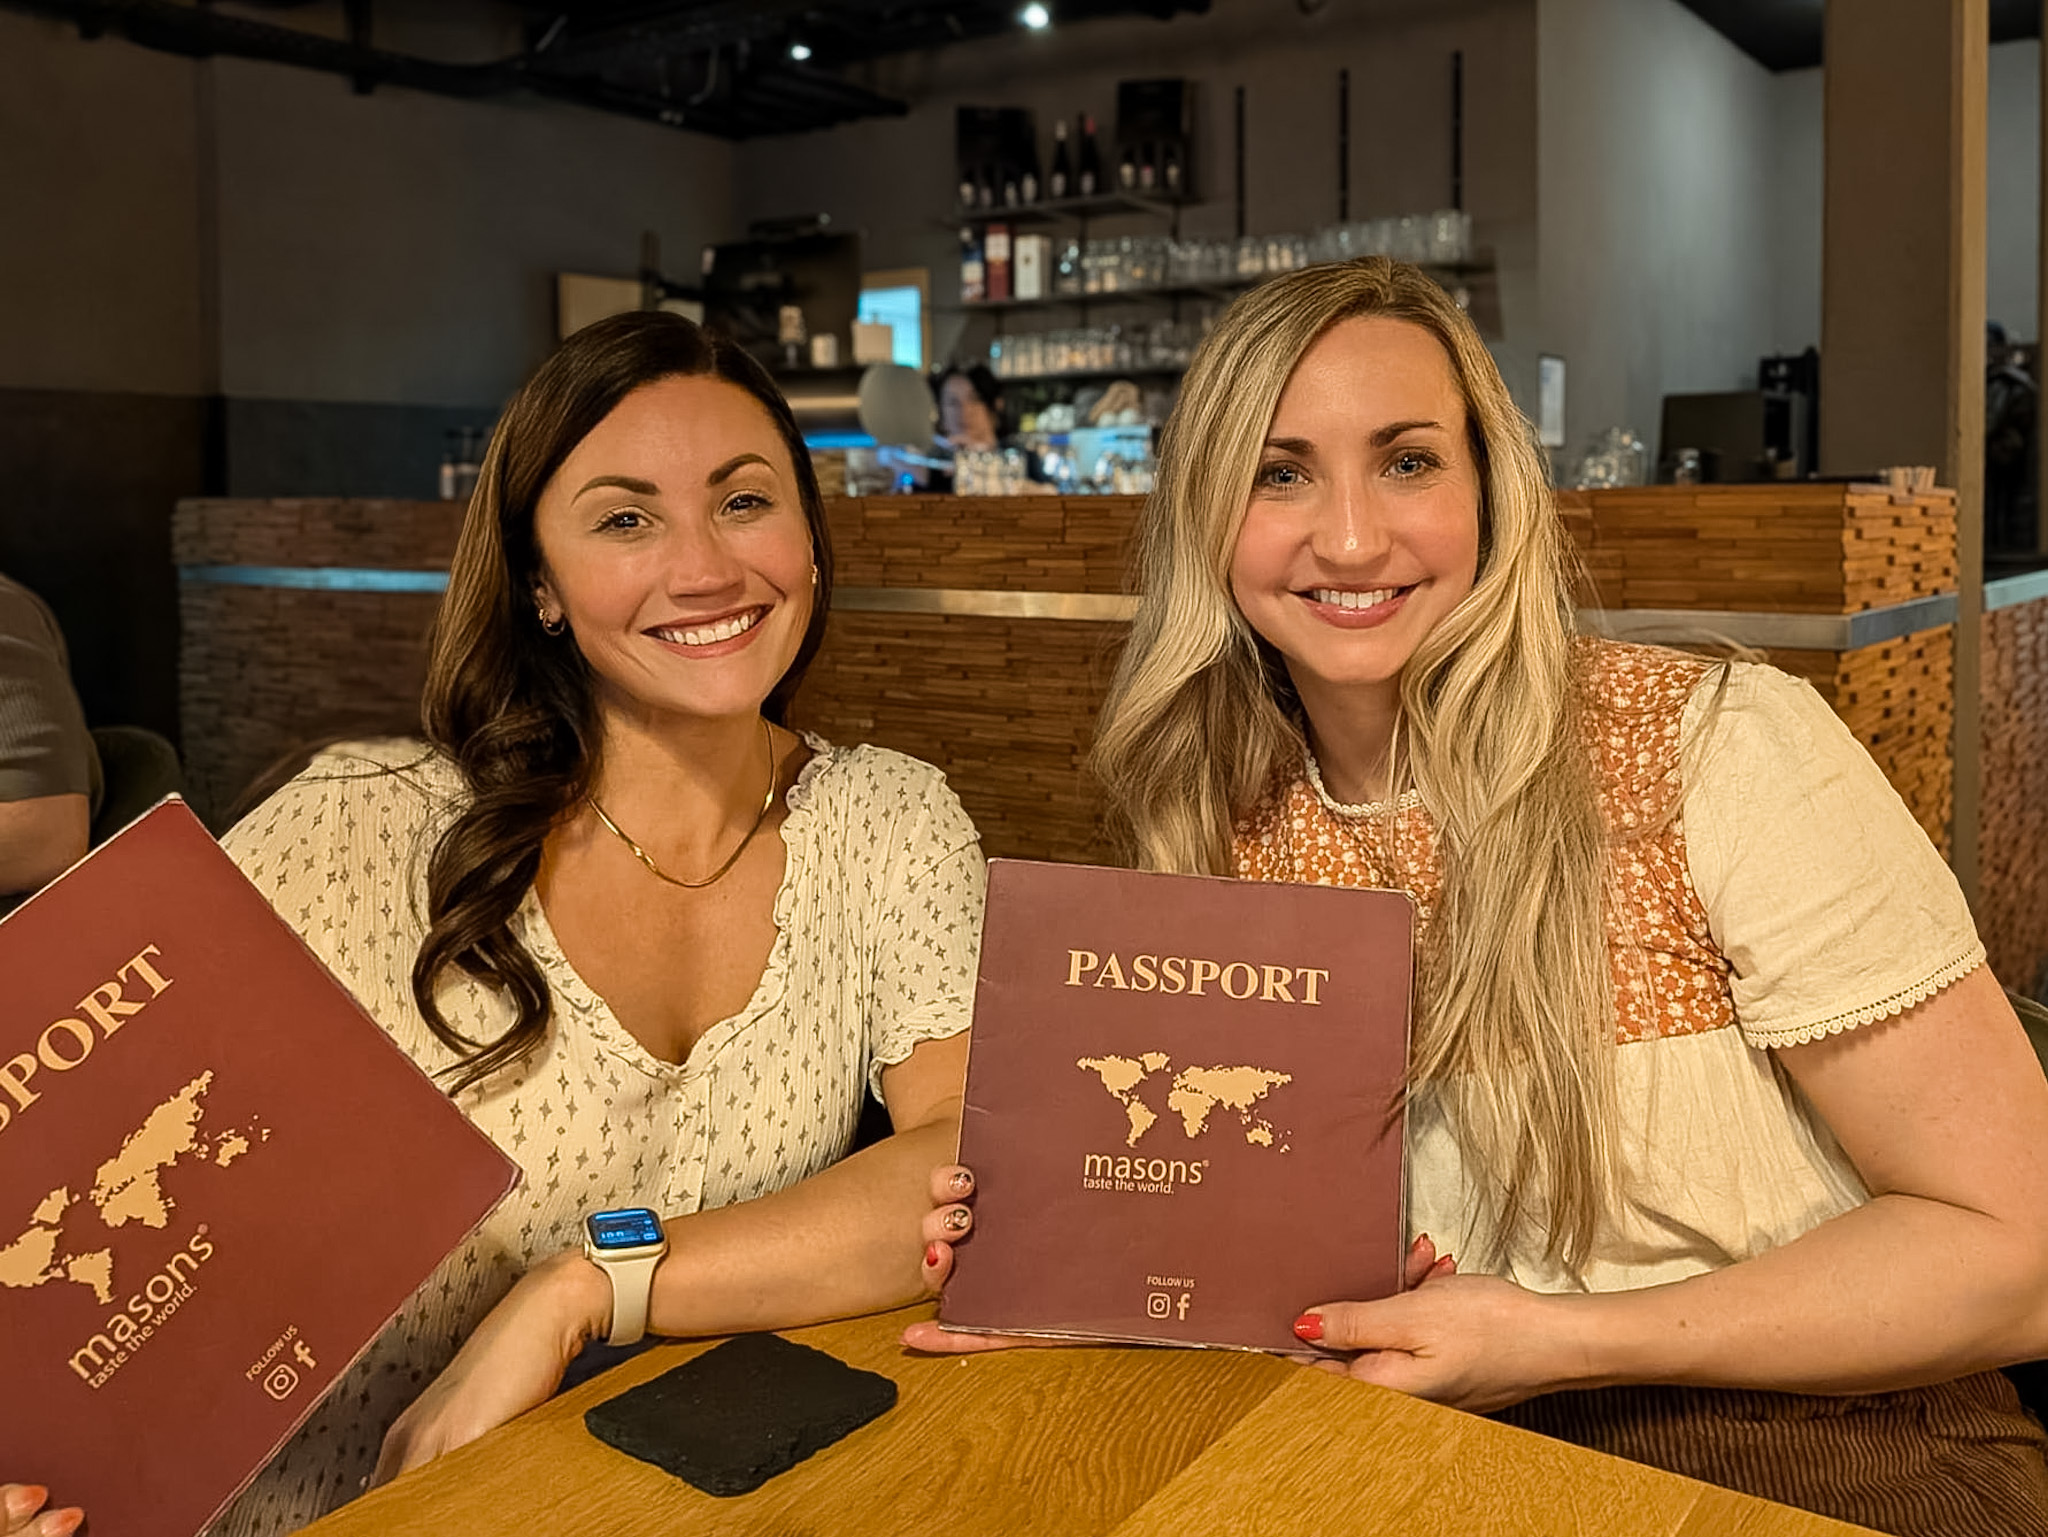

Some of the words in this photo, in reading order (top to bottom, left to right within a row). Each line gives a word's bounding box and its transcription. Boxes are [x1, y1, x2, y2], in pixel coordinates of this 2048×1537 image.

[1064, 949, 1330, 1006] PASSPORT
[0, 943, 174, 1133] PORT
[1083, 1177, 1113, 1190] taste
[1115, 1177, 1135, 1191] the
[1137, 1180, 1174, 1195] world.
[1147, 1275, 1182, 1287] FOLLOW
[1183, 1278, 1195, 1289] US
[88, 1350, 129, 1389] taste
[125, 1325, 154, 1352] the
[151, 1282, 198, 1326] world.
[245, 1337, 285, 1381] FOLLOW
[281, 1324, 298, 1341] US
